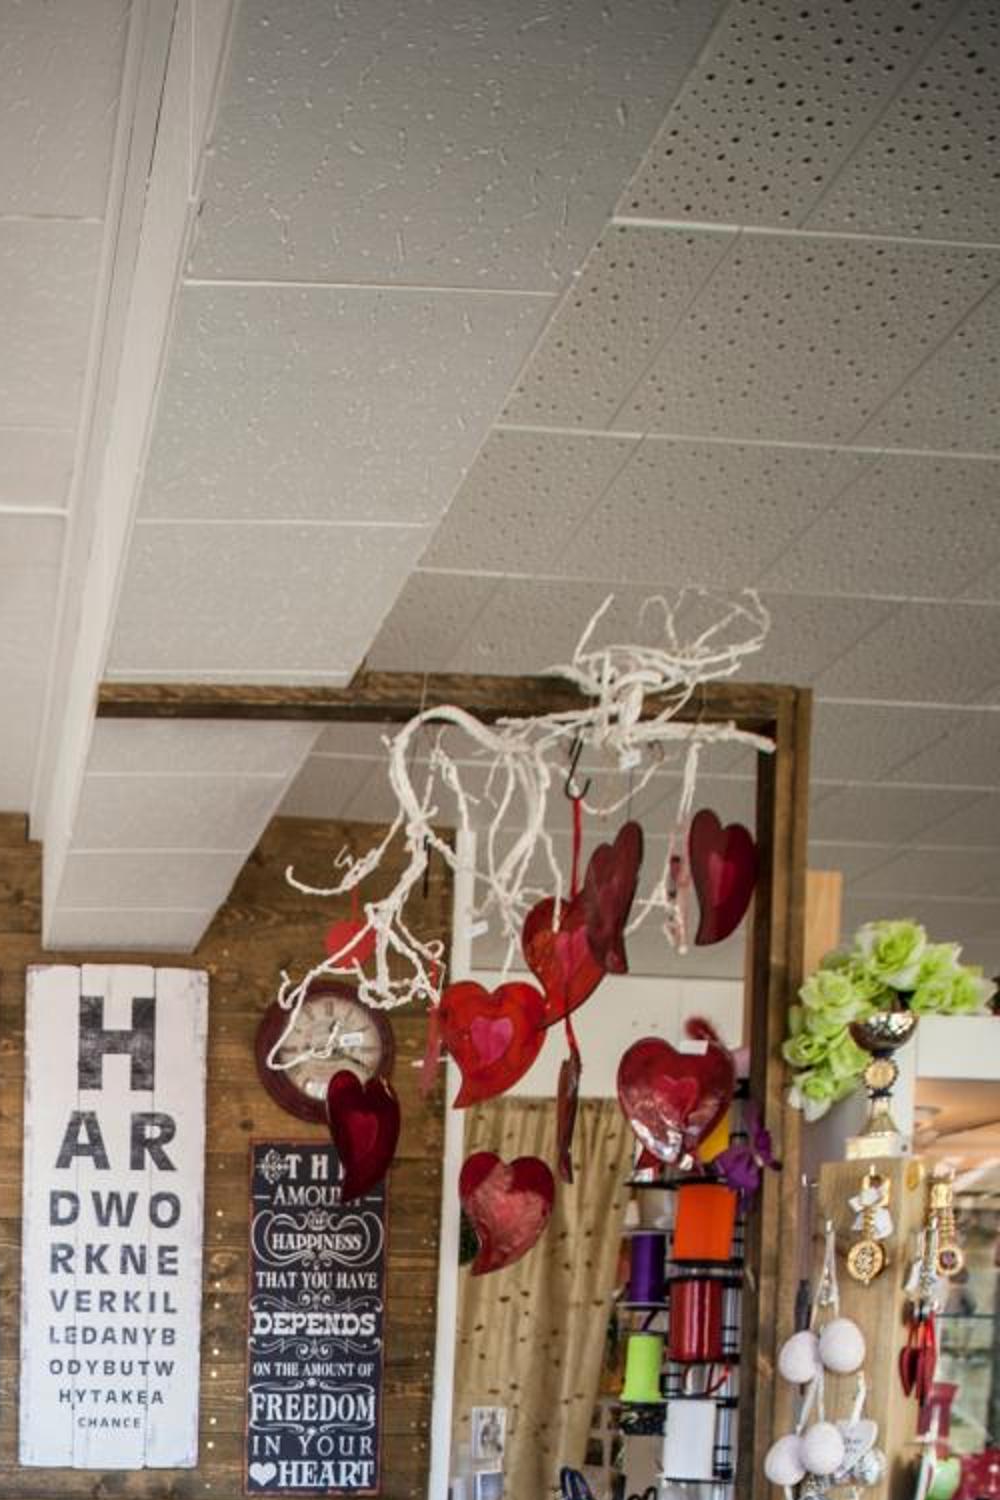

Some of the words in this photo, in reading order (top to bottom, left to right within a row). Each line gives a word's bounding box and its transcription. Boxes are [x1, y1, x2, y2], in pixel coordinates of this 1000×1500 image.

[78, 995, 156, 1091] H
[272, 1185, 362, 1207] AMOU
[49, 1189, 181, 1229] DWO
[271, 1232, 363, 1251] HAPPINESS
[50, 1243, 179, 1276] RKNE
[256, 1271, 298, 1289] THAT
[301, 1271, 333, 1289] YOU
[336, 1271, 378, 1289] HAVE
[49, 1288, 178, 1314] VERKIL
[252, 1311, 377, 1336] DEPENDS
[48, 1325, 176, 1346] LEDANYB
[48, 1358, 175, 1377] ODYBUTW
[253, 1361, 271, 1377] ON
[274, 1362, 300, 1377] THE
[303, 1362, 355, 1377] AMOUNT
[358, 1362, 376, 1377] OF
[58, 1388, 164, 1405] HYTAKEA
[251, 1392, 377, 1422] FREEDOM
[77, 1416, 142, 1429] CHANCE
[252, 1435, 281, 1456] IN
[298, 1435, 374, 1456] YOUR
[277, 1460, 375, 1488] HEART
